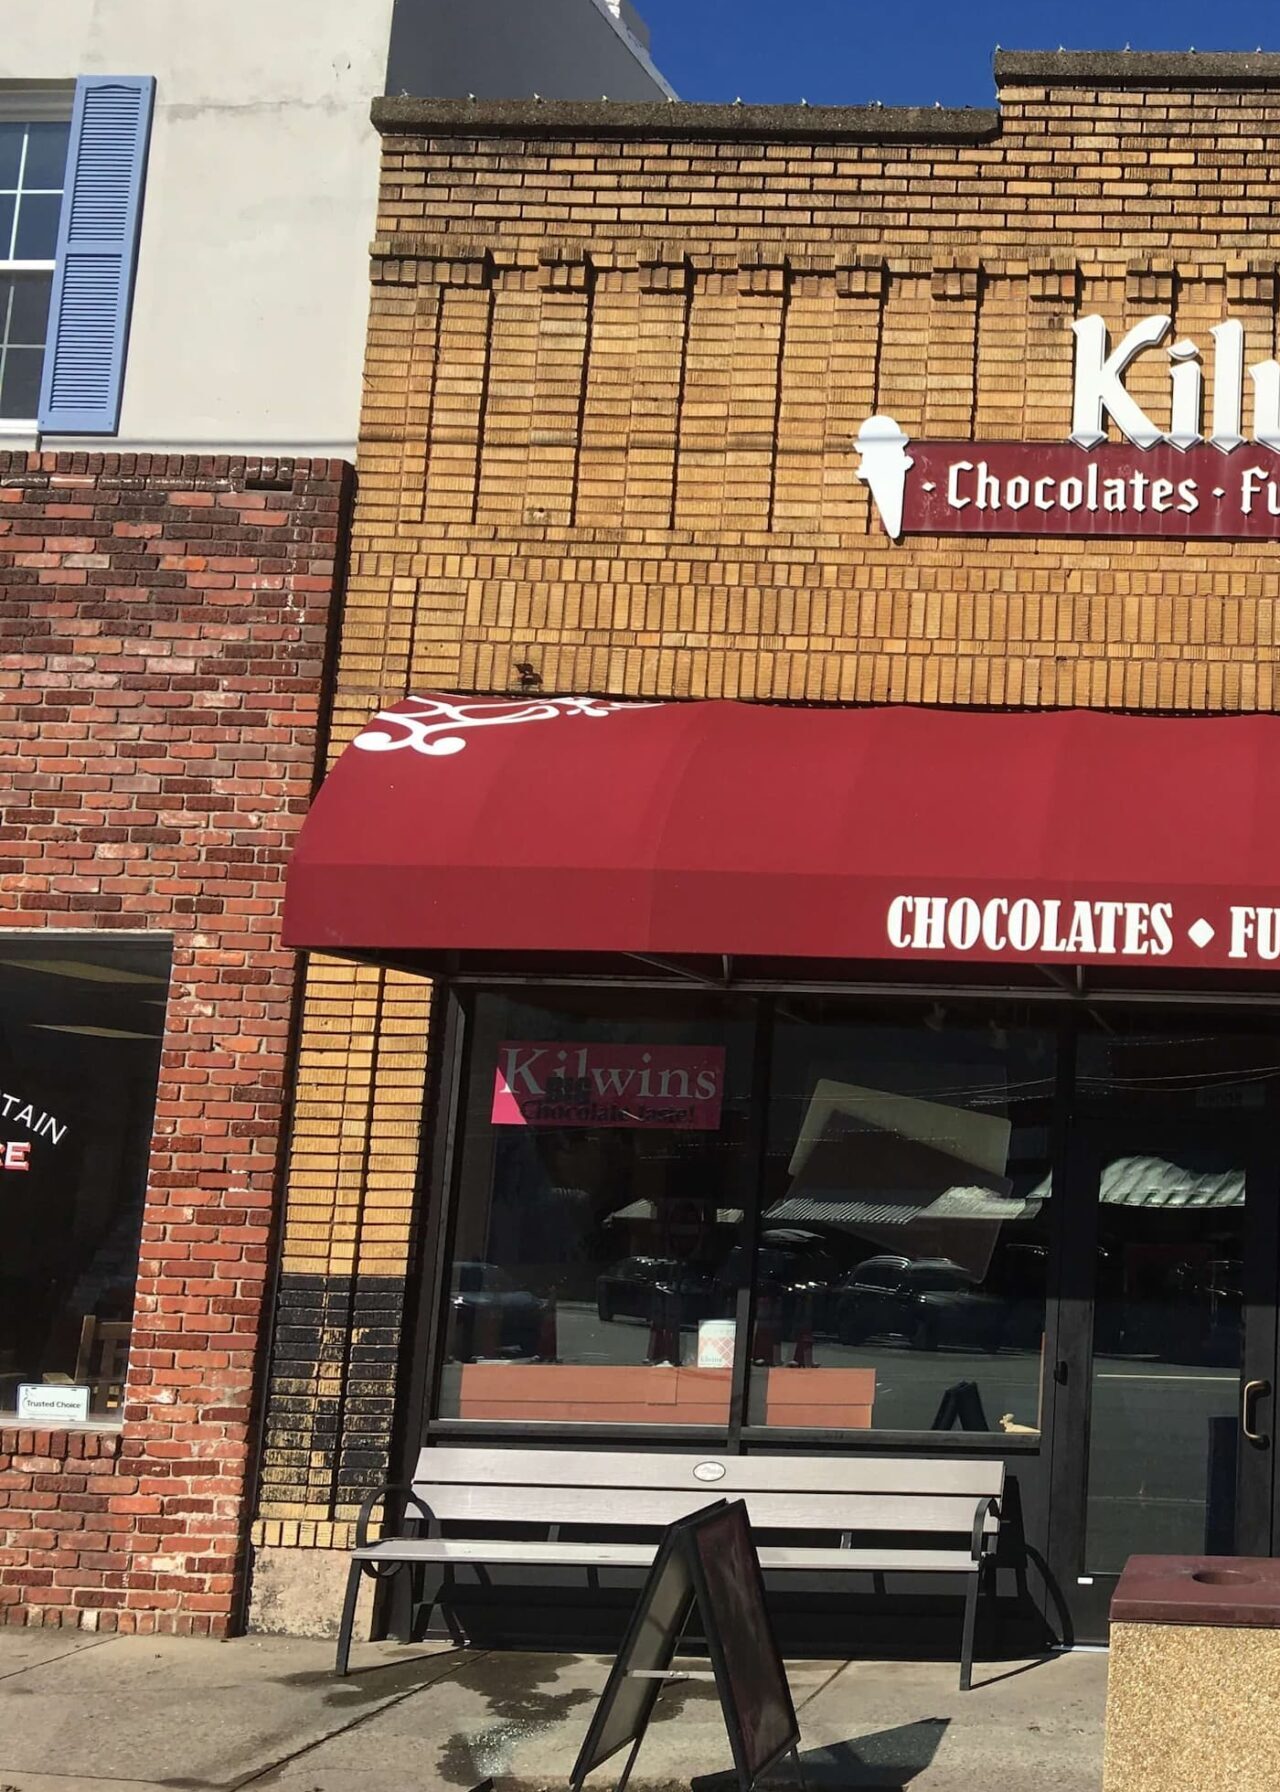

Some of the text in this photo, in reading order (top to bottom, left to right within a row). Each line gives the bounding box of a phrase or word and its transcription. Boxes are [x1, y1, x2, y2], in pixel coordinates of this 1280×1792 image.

[944, 460, 1200, 514] Chocolates
[886, 895, 1174, 956] CHOCOLATES
[498, 1047, 717, 1100] Kilwins
[0, 1090, 68, 1145] TAIN
[0, 1141, 32, 1171] E
[26, 1400, 81, 1409] Trusted Choice
